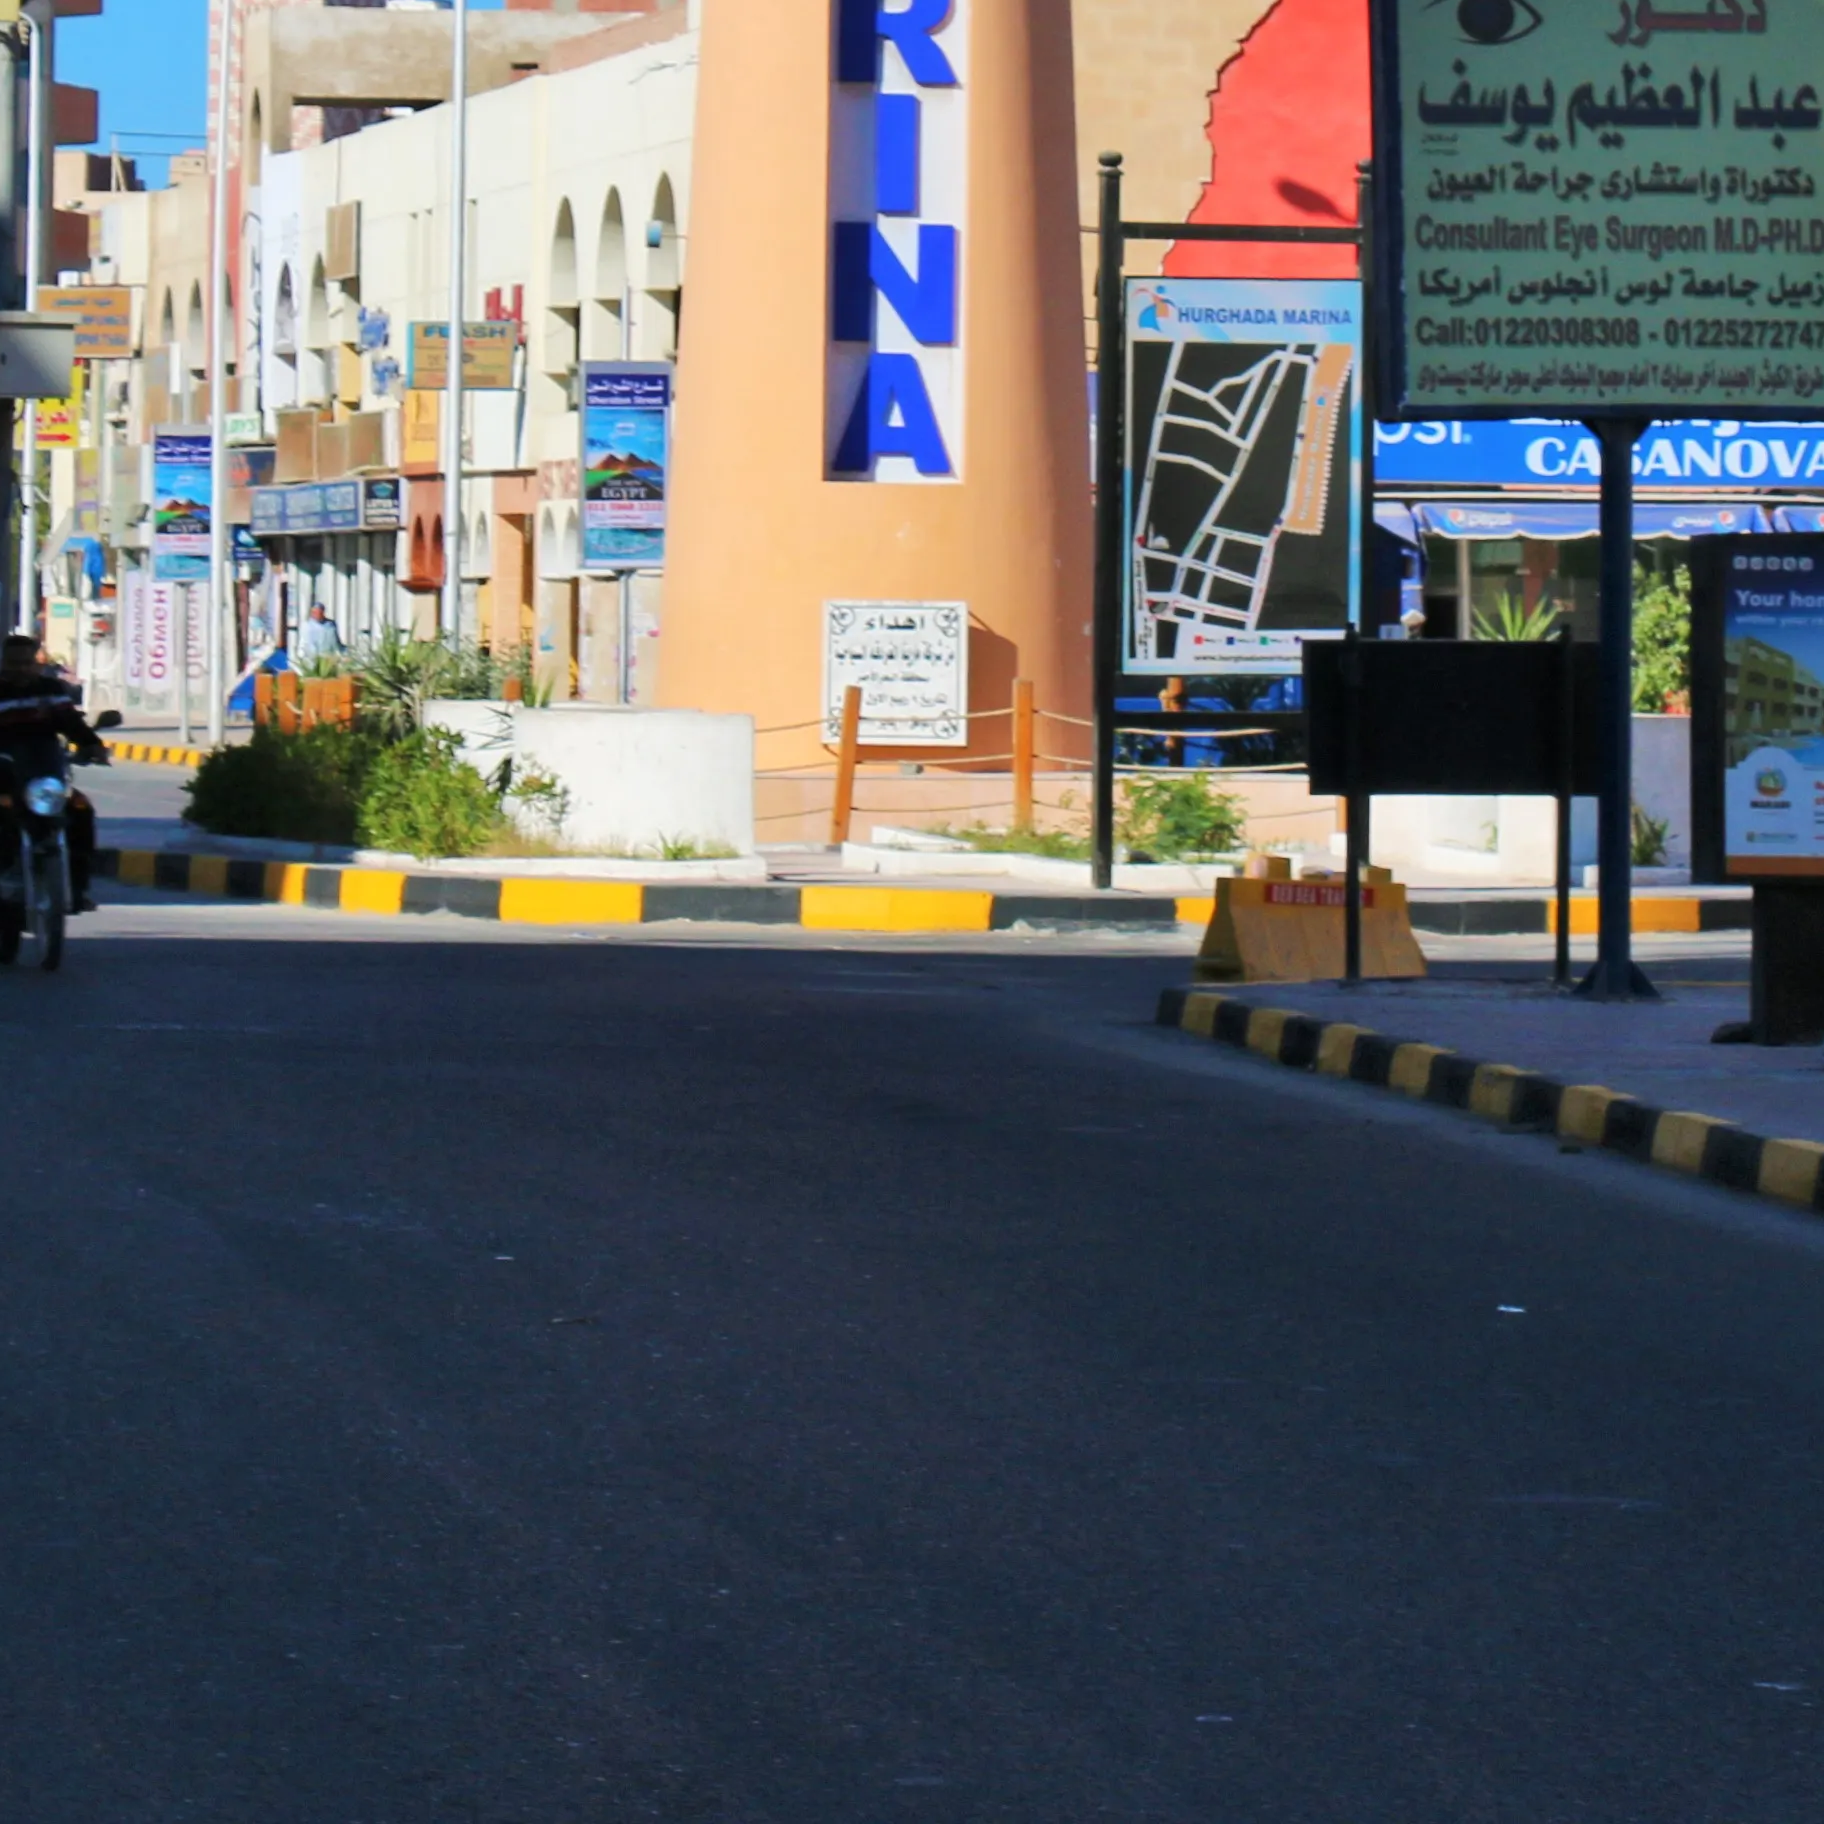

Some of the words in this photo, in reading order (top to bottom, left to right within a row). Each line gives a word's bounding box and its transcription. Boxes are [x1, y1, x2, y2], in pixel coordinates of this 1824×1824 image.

[1418, 58, 1561, 152] يوسف
[1567, 59, 1721, 151] العظيم
[1733, 71, 1823, 152] عبد
[1427, 167, 1506, 203] العيون
[1512, 162, 1594, 200] جراحة
[1415, 214, 1547, 253] Consultant
[1554, 216, 1598, 260] Eye
[1605, 215, 1706, 261] Surgeon
[1614, 272, 1673, 306] لوس
[1681, 269, 1760, 305] جامعة
[1177, 307, 1278, 325] HURGHADA
[1282, 307, 1353, 325] MARINA
[1415, 315, 1640, 348] Call:01220308308
[1734, 589, 1785, 607] Your
[148, 588, 168, 680] Обмен
